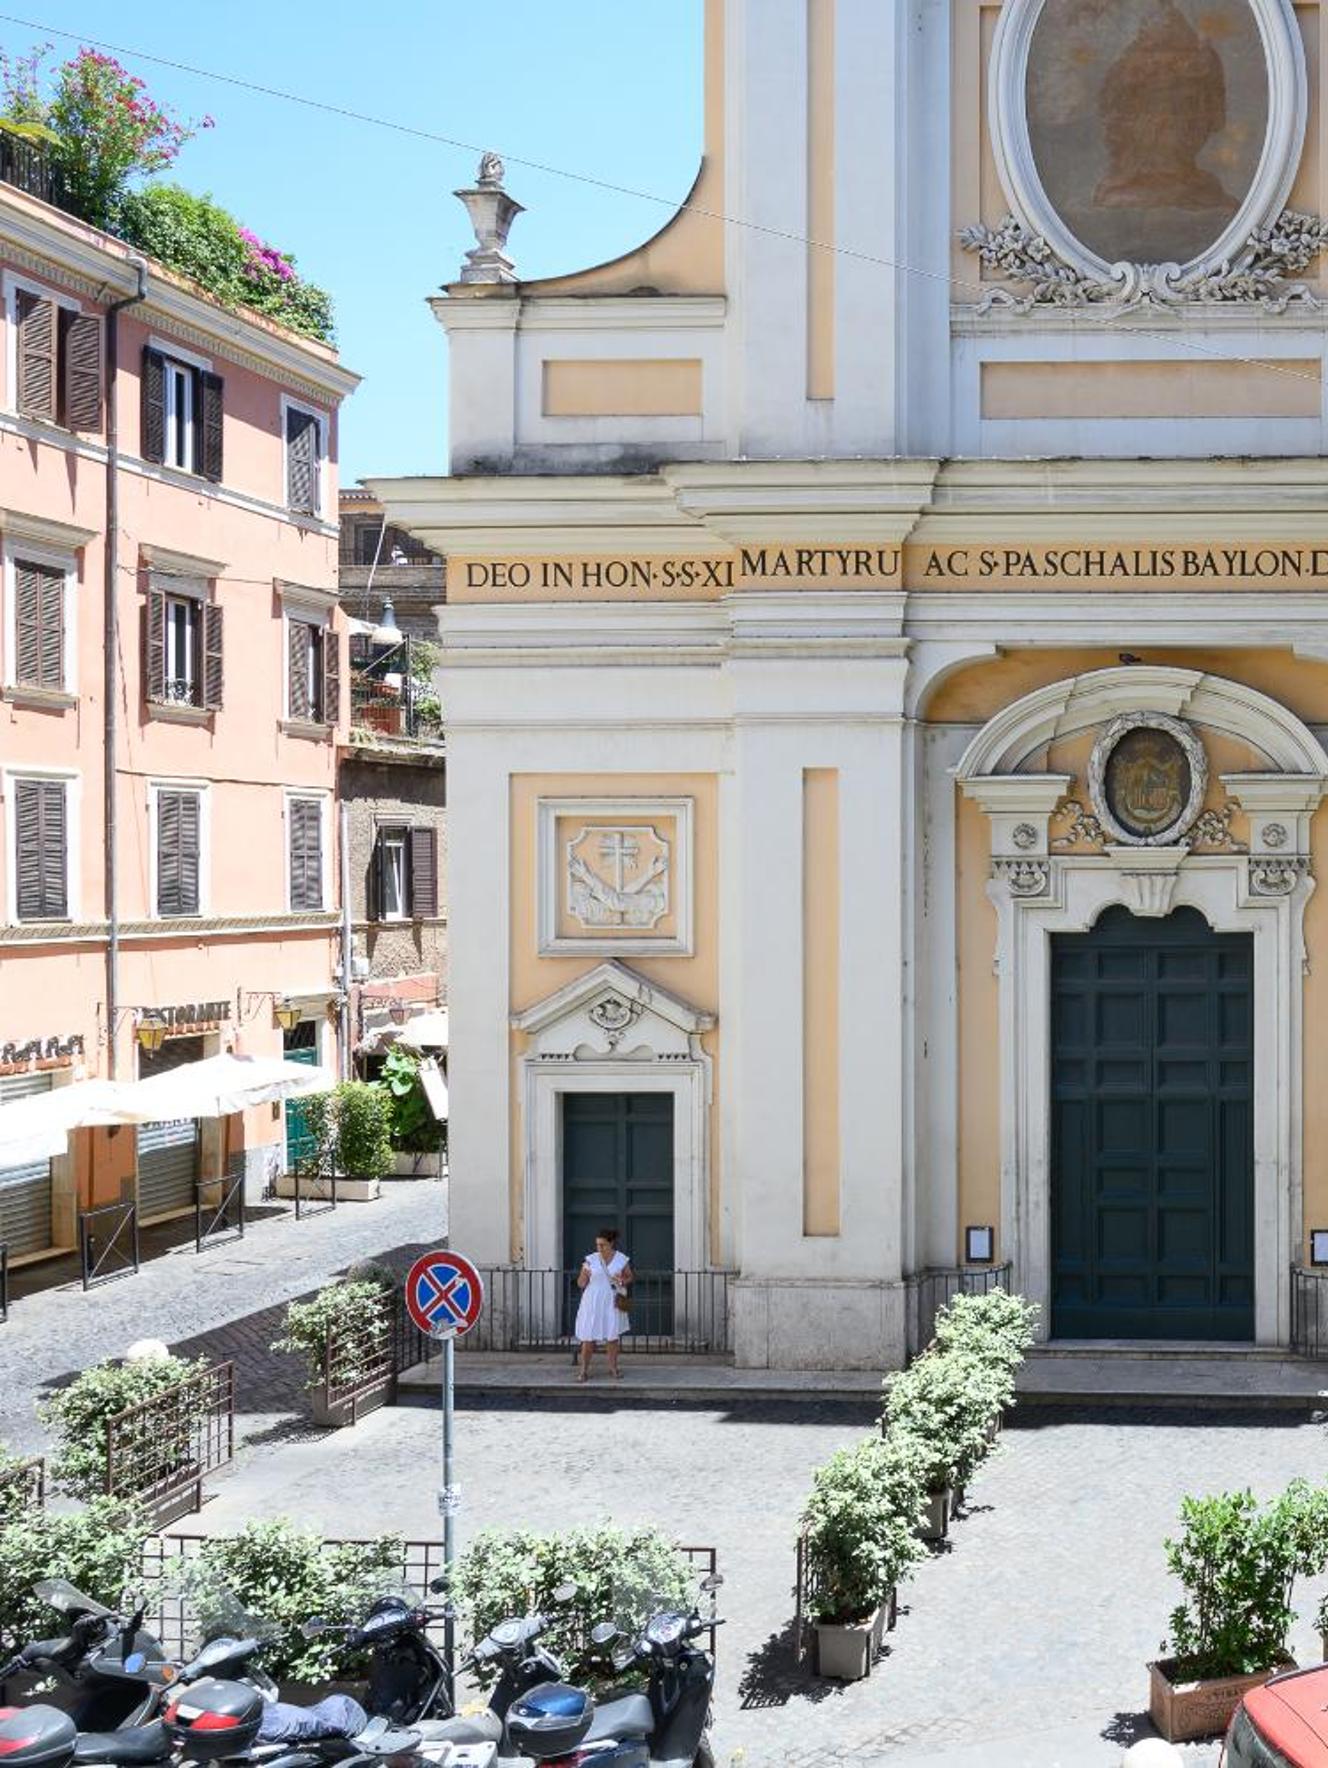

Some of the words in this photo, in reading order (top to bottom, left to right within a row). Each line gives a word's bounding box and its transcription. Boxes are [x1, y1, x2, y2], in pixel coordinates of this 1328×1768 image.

[466, 562, 531, 588] DEO
[541, 562, 573, 588] IN
[740, 548, 899, 577] MARTYRU
[922, 549, 969, 577] AC
